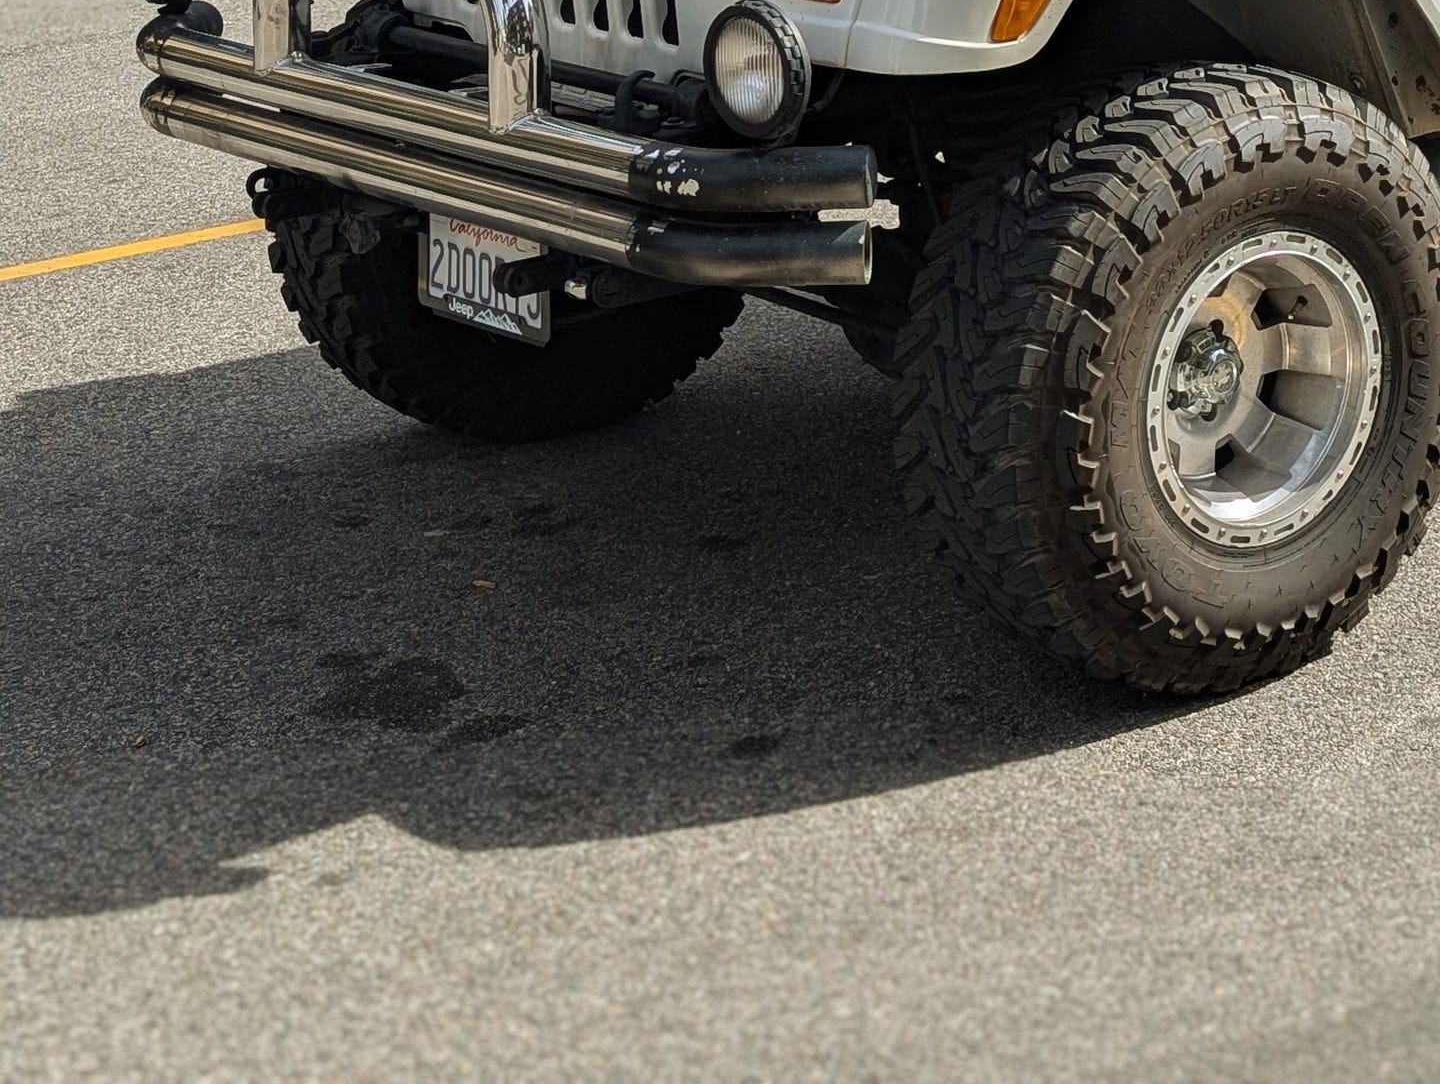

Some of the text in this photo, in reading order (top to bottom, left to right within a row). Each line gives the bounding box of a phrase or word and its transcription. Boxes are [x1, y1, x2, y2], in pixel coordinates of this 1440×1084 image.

[1306, 177, 1410, 266] OPEN
[449, 297, 474, 320] Jeep
[1119, 489, 1232, 609] TOYO
